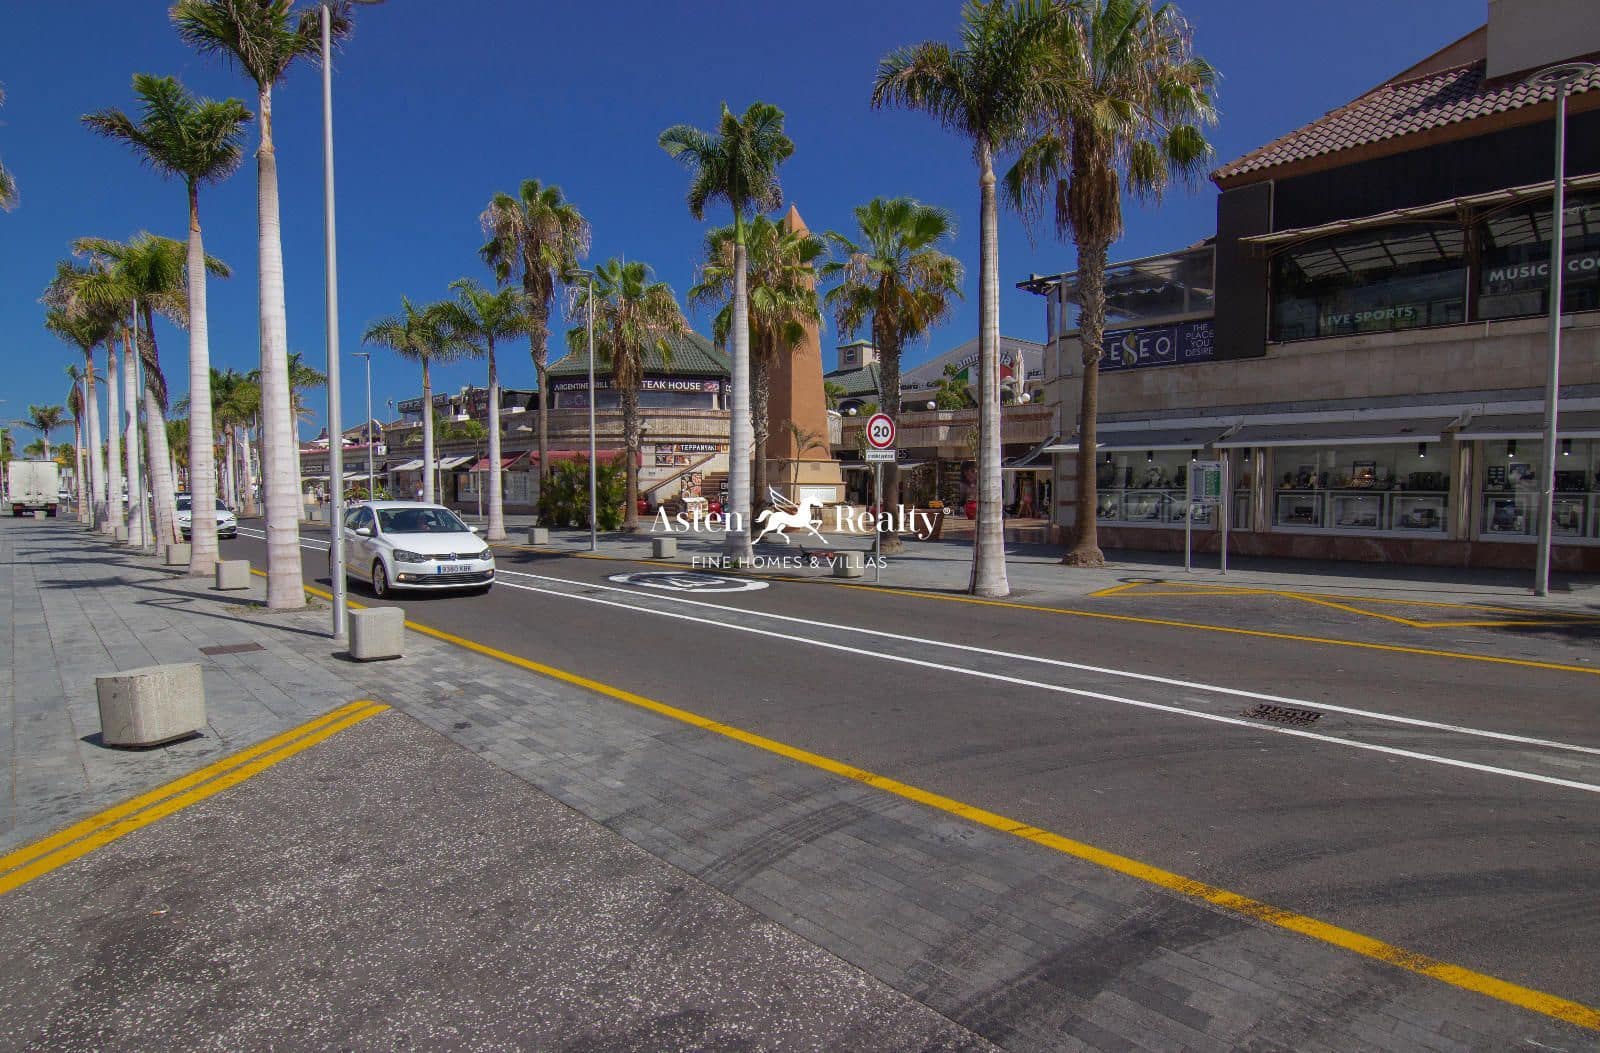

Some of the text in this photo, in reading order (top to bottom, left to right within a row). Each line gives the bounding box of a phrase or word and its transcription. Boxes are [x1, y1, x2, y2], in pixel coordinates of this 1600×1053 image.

[1489, 257, 1600, 282] MUSIC CO
[1319, 311, 1351, 327] LIVE
[1193, 323, 1209, 331] THE
[1186, 330, 1215, 340] PLACE
[1190, 339, 1210, 347] YOU
[1110, 332, 1171, 366] ESEO
[1185, 346, 1214, 357] DESIRE
[554, 382, 590, 391] ARGENTINE
[641, 380, 666, 389] TEAK
[668, 381, 701, 390] HOUSE
[873, 425, 890, 438] 20
[681, 443, 717, 451] TEPPANYAKI
